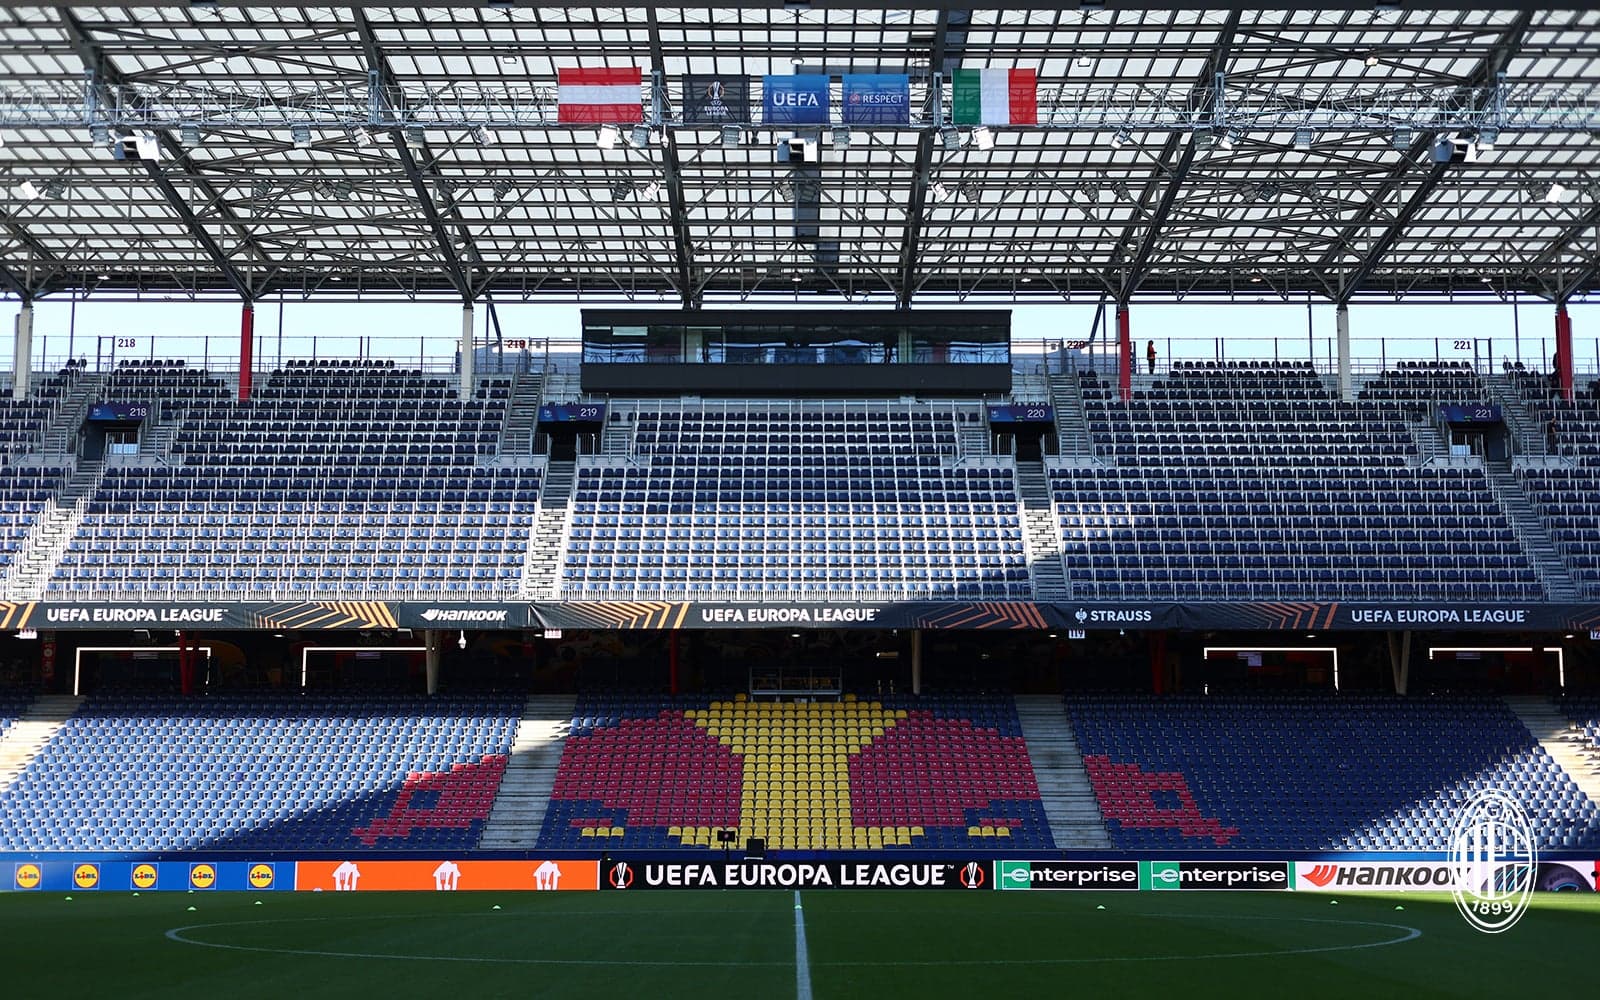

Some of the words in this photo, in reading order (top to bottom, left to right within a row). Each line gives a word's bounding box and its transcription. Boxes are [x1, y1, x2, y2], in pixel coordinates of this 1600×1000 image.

[773, 93, 819, 106] UEFA
[863, 95, 903, 104] RESPECT
[118, 338, 136, 347] 218
[1454, 341, 1471, 349] 221
[130, 407, 147, 416] 218
[580, 408, 597, 417] 219
[1027, 409, 1045, 418] 220
[1475, 409, 1492, 418] 221
[47, 608, 89, 621] UEFA
[93, 608, 157, 621] EUROPA
[702, 608, 744, 621] UEFA
[748, 608, 810, 621] EUROPA
[1090, 610, 1152, 621] STRAUSS
[1351, 609, 1394, 622] UEFA
[1397, 609, 1460, 622] EUROPA
[645, 864, 718, 886] UEFA
[724, 864, 833, 886] EUROPA
[1010, 866, 1137, 886] enterprise
[1159, 866, 1287, 886] enterprise
